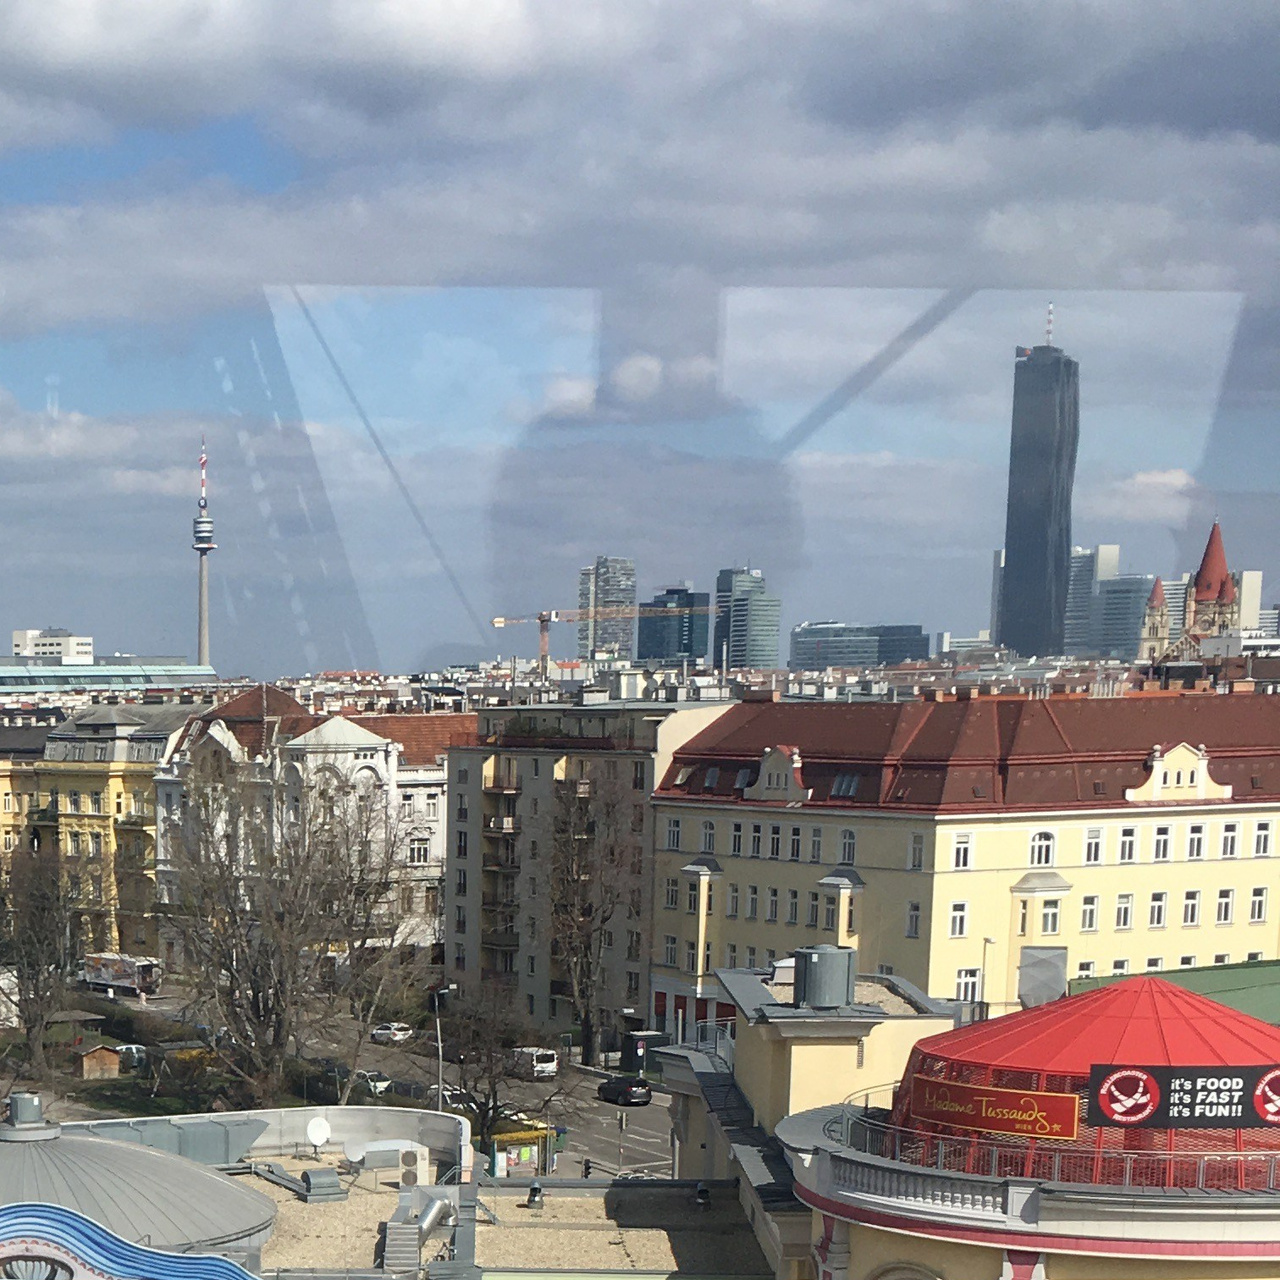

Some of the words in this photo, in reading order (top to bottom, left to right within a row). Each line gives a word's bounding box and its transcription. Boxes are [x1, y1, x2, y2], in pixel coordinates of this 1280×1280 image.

[1100, 1070, 1148, 1095] ROLLERCOASTER
[1196, 1078, 1244, 1090] FOOD
[1196, 1092, 1243, 1104] FAST
[925, 1087, 976, 1116] Madame
[973, 1097, 1050, 1133] Tussauds
[1194, 1105, 1243, 1117] FUN!!
